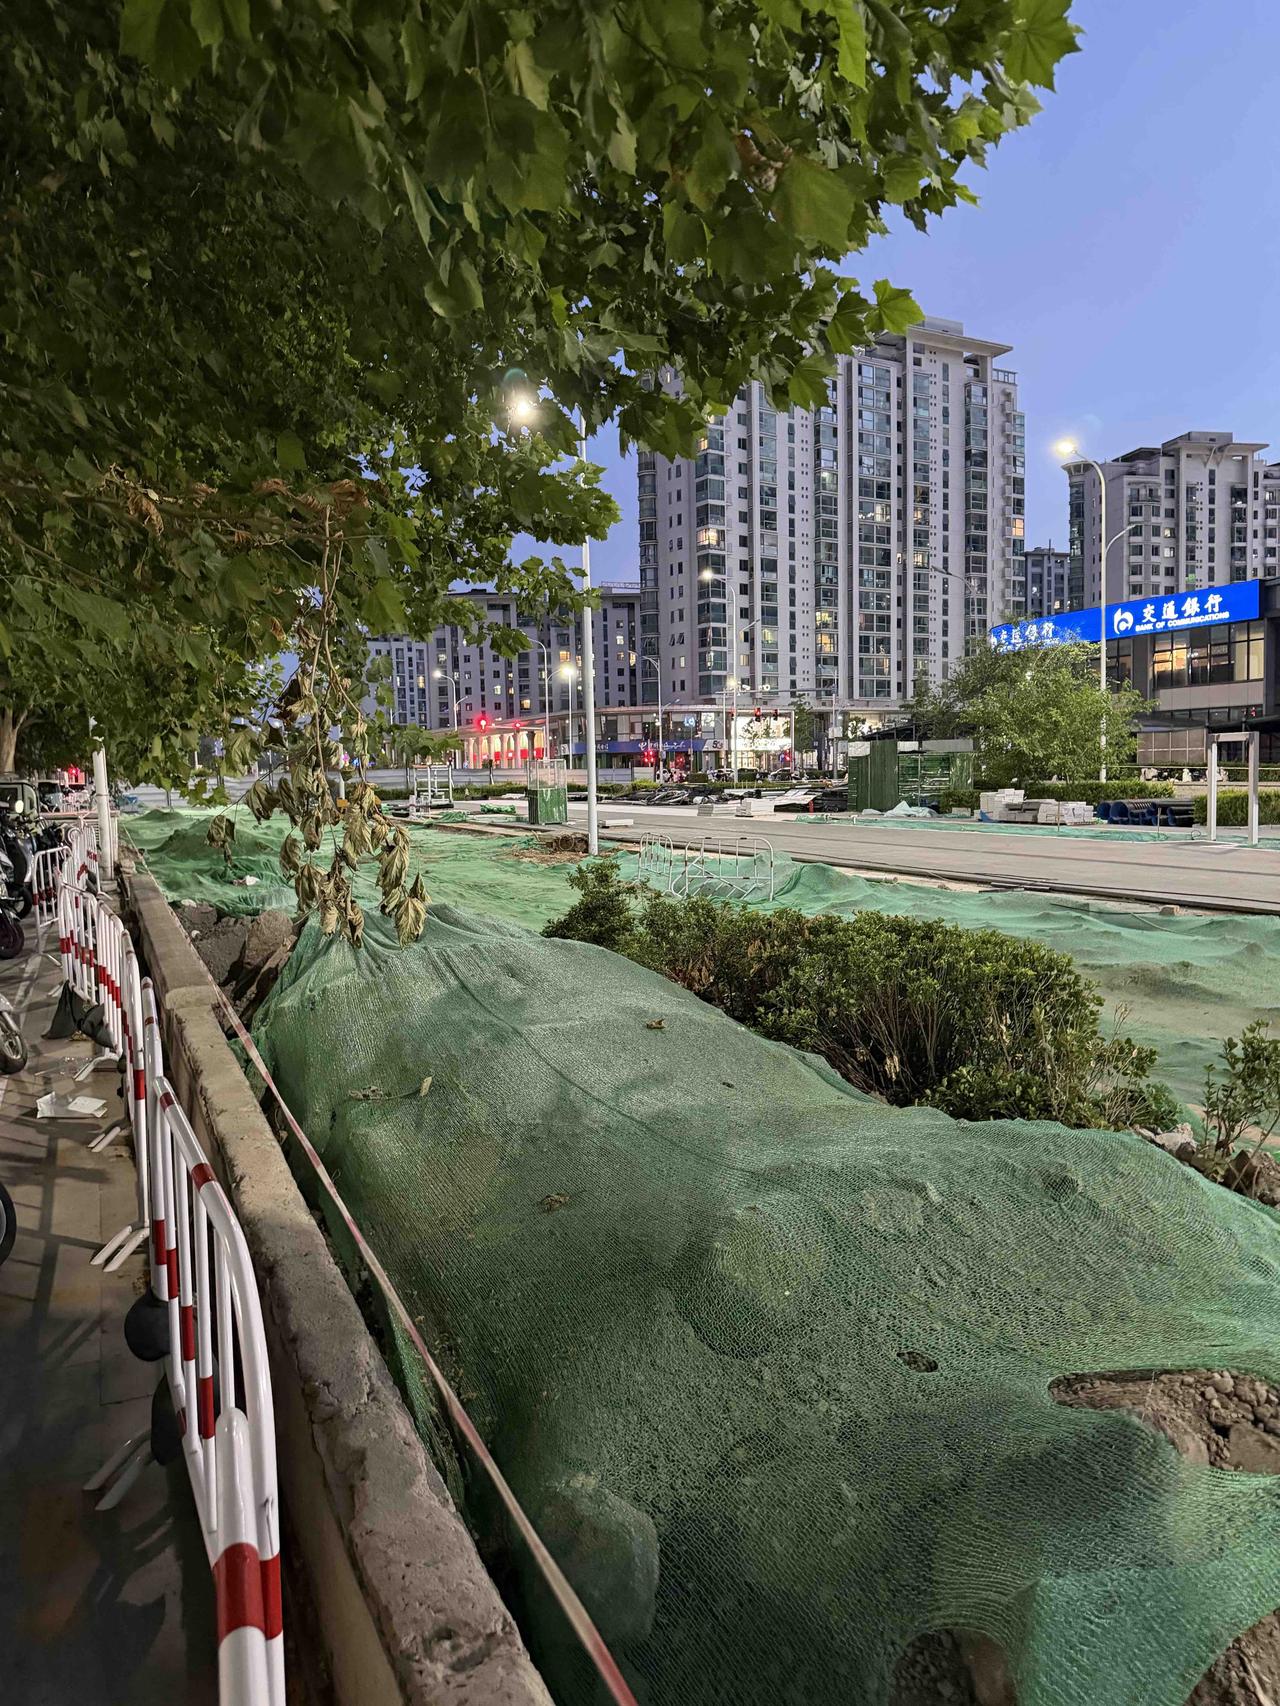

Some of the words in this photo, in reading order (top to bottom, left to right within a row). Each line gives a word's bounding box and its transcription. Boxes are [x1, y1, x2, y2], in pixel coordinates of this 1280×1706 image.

[1135, 623, 1154, 632] BANK
[1155, 621, 1166, 629] OF
[1167, 611, 1230, 628] COMMUNICATIONS
